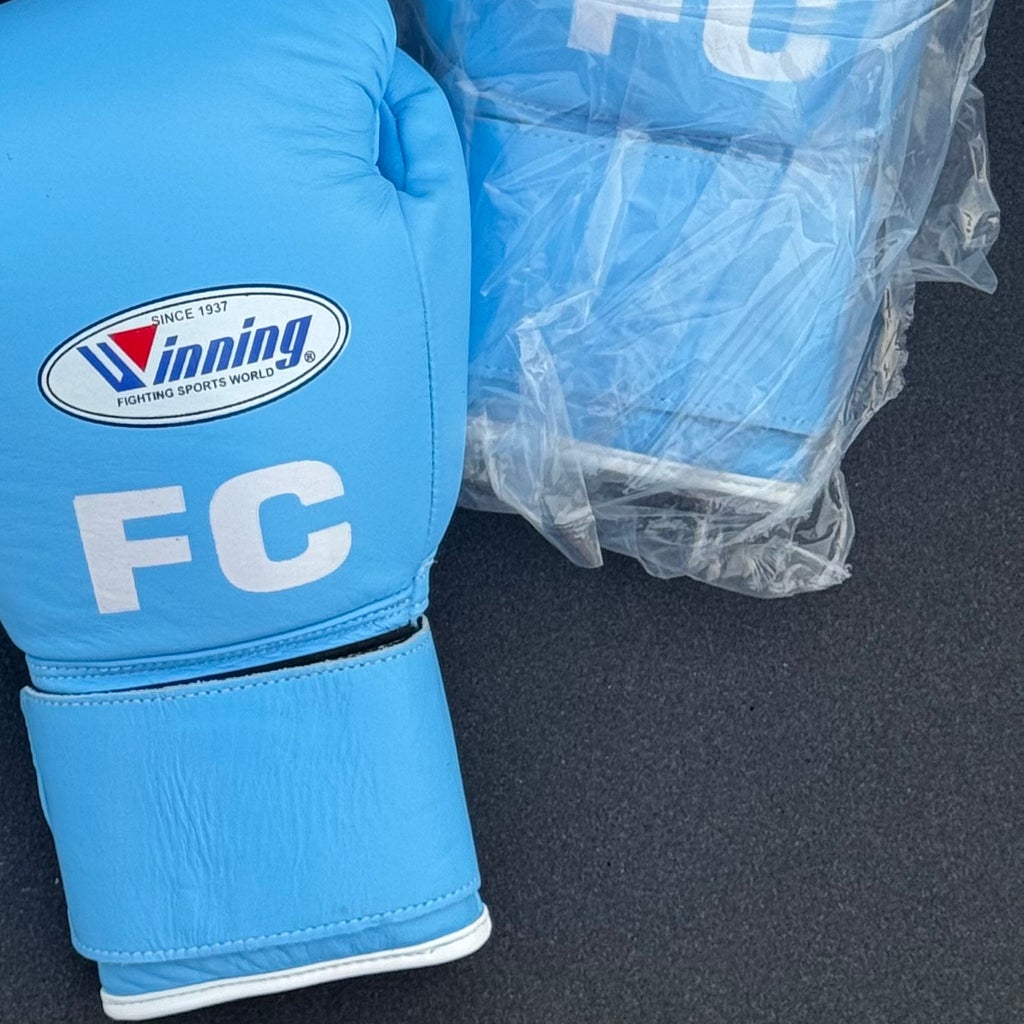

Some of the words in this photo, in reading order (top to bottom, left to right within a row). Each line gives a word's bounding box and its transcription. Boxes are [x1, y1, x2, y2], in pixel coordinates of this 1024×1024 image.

[151, 307, 194, 327] SINCE
[198, 300, 228, 317] 1937
[76, 314, 313, 393] Winning
[117, 386, 174, 407] FIGHTING
[177, 377, 227, 396] SPORTS
[229, 367, 274, 385] WORLD
[72, 459, 352, 614] FC
